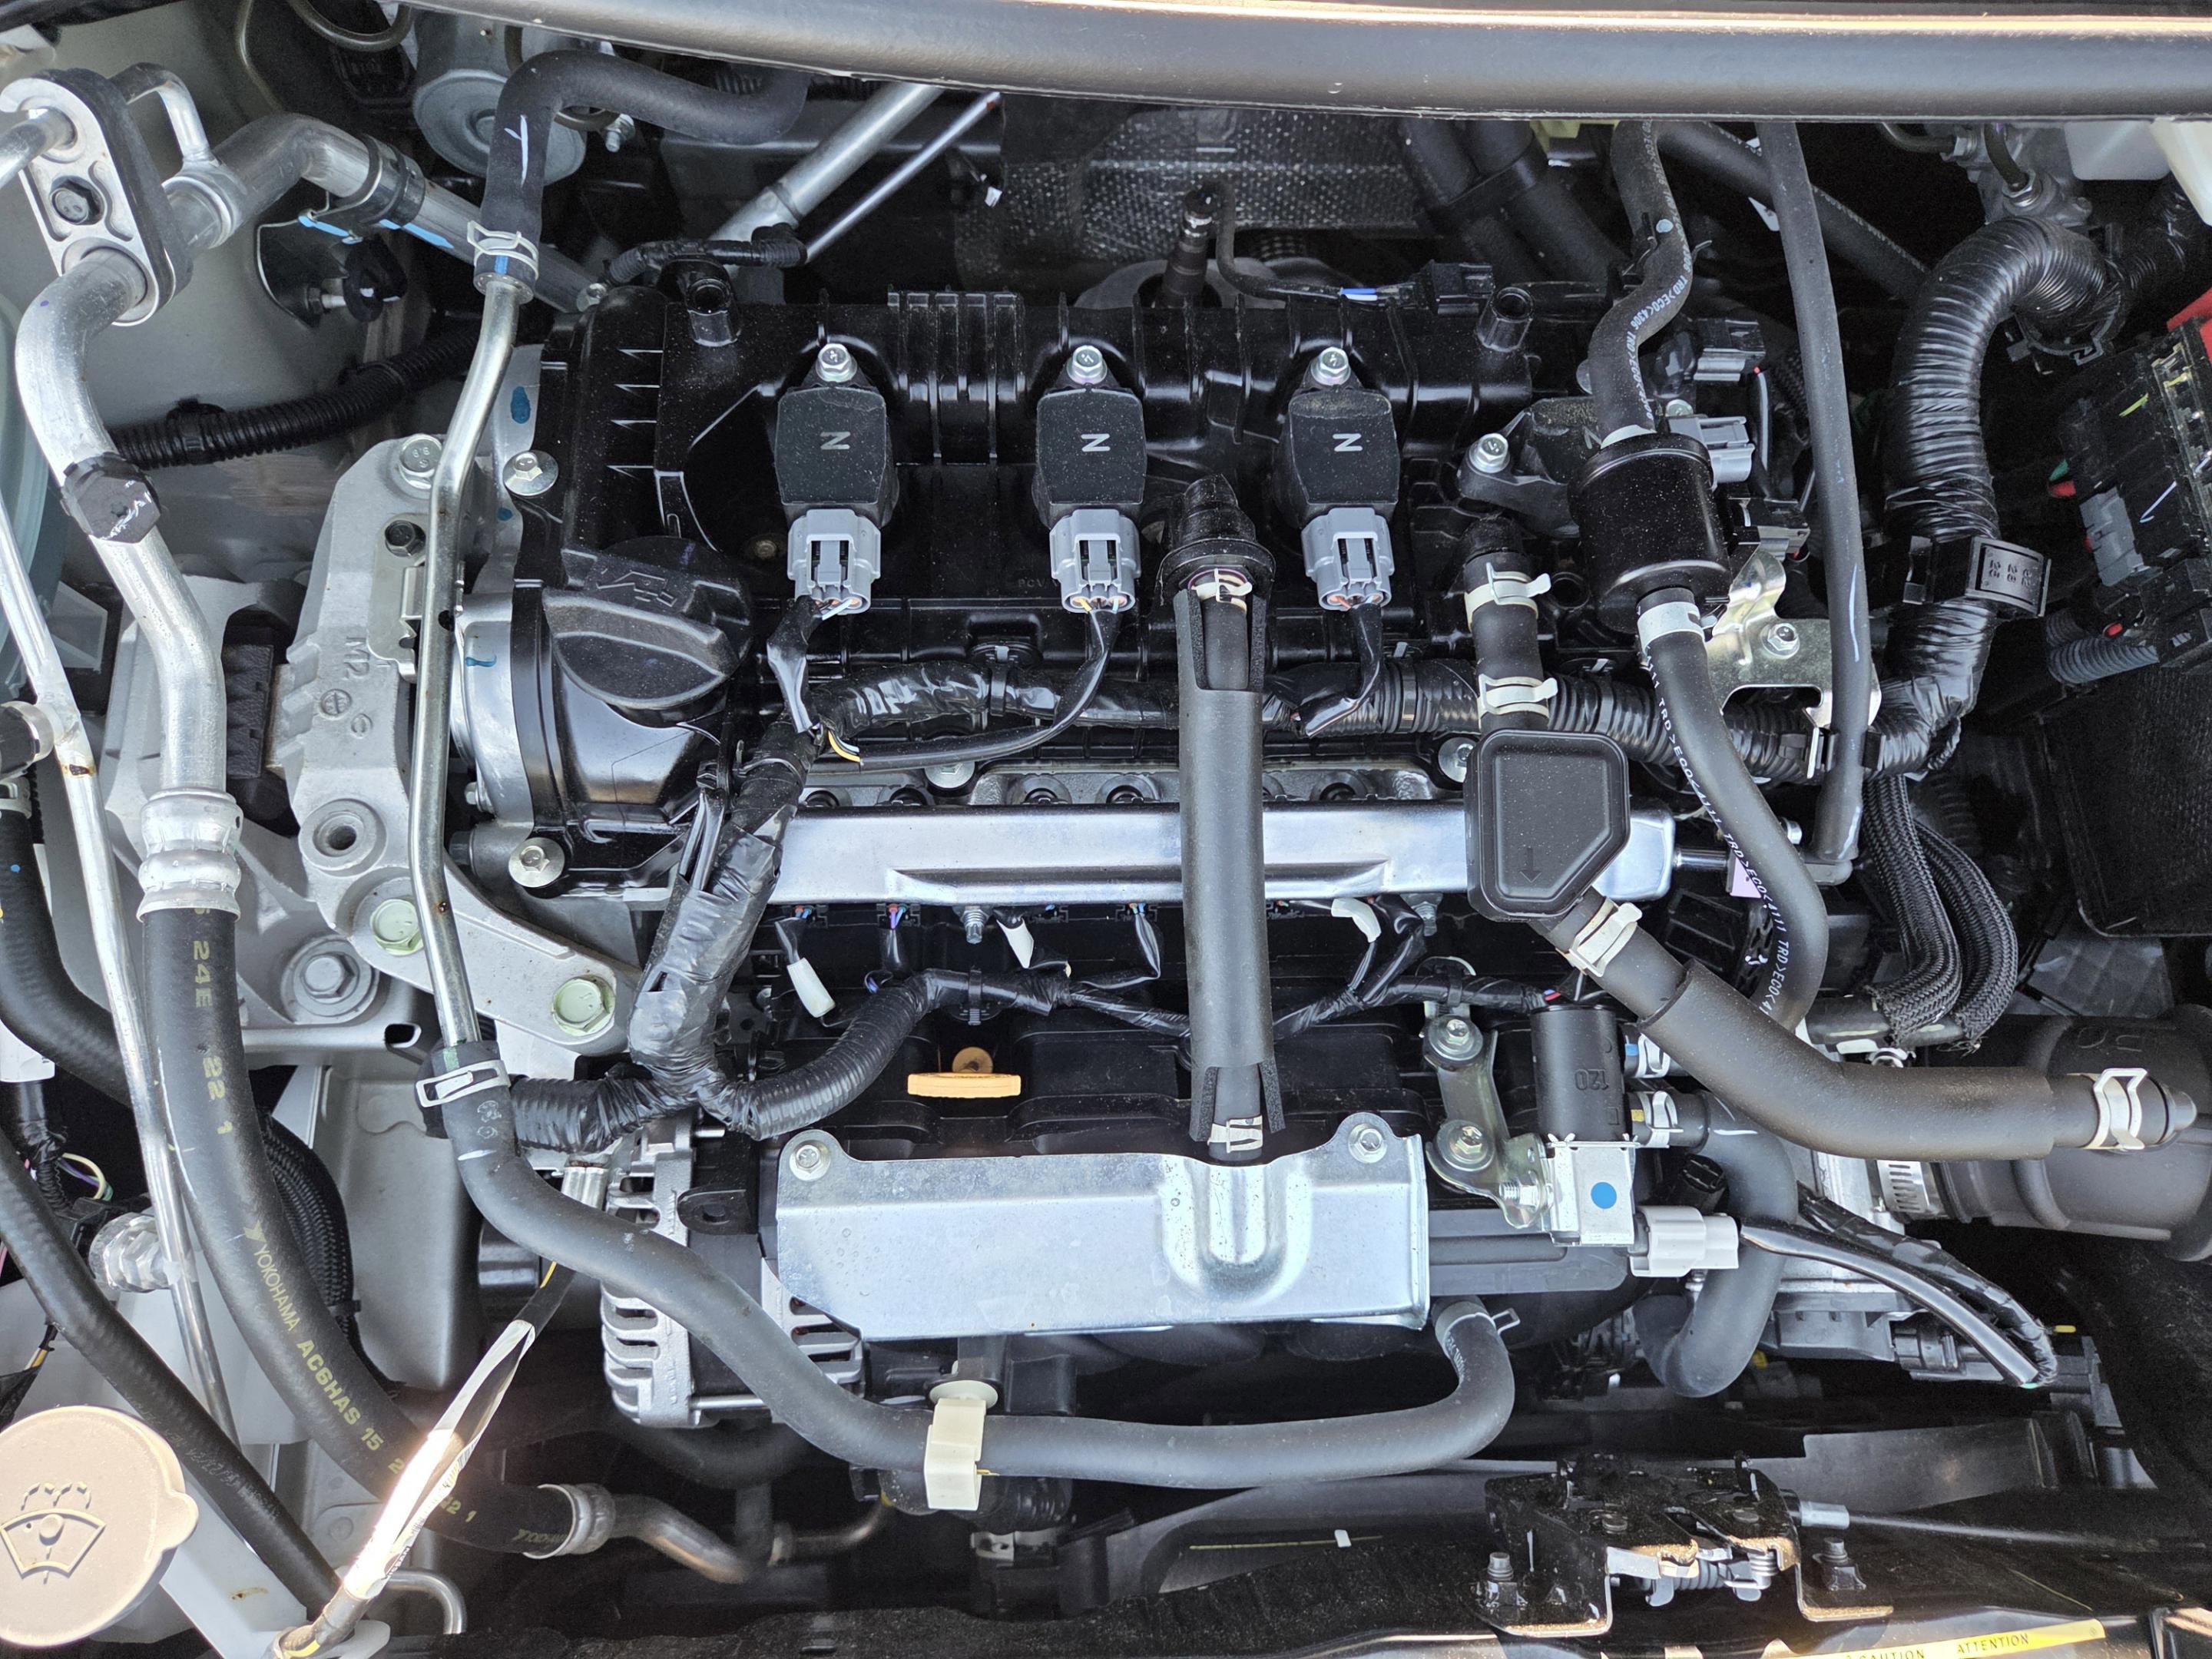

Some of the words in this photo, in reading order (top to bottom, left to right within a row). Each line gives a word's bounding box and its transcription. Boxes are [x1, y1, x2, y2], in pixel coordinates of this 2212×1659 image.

[193, 940, 213, 1008] 24E
[1759, 939, 1790, 1015] TRD>ECO<41
[202, 1055, 226, 1101] 22
[253, 1243, 300, 1332] YOKOHAMA
[361, 1427, 384, 1451] 15
[1958, 1632, 2029, 1654] ATTENTION
